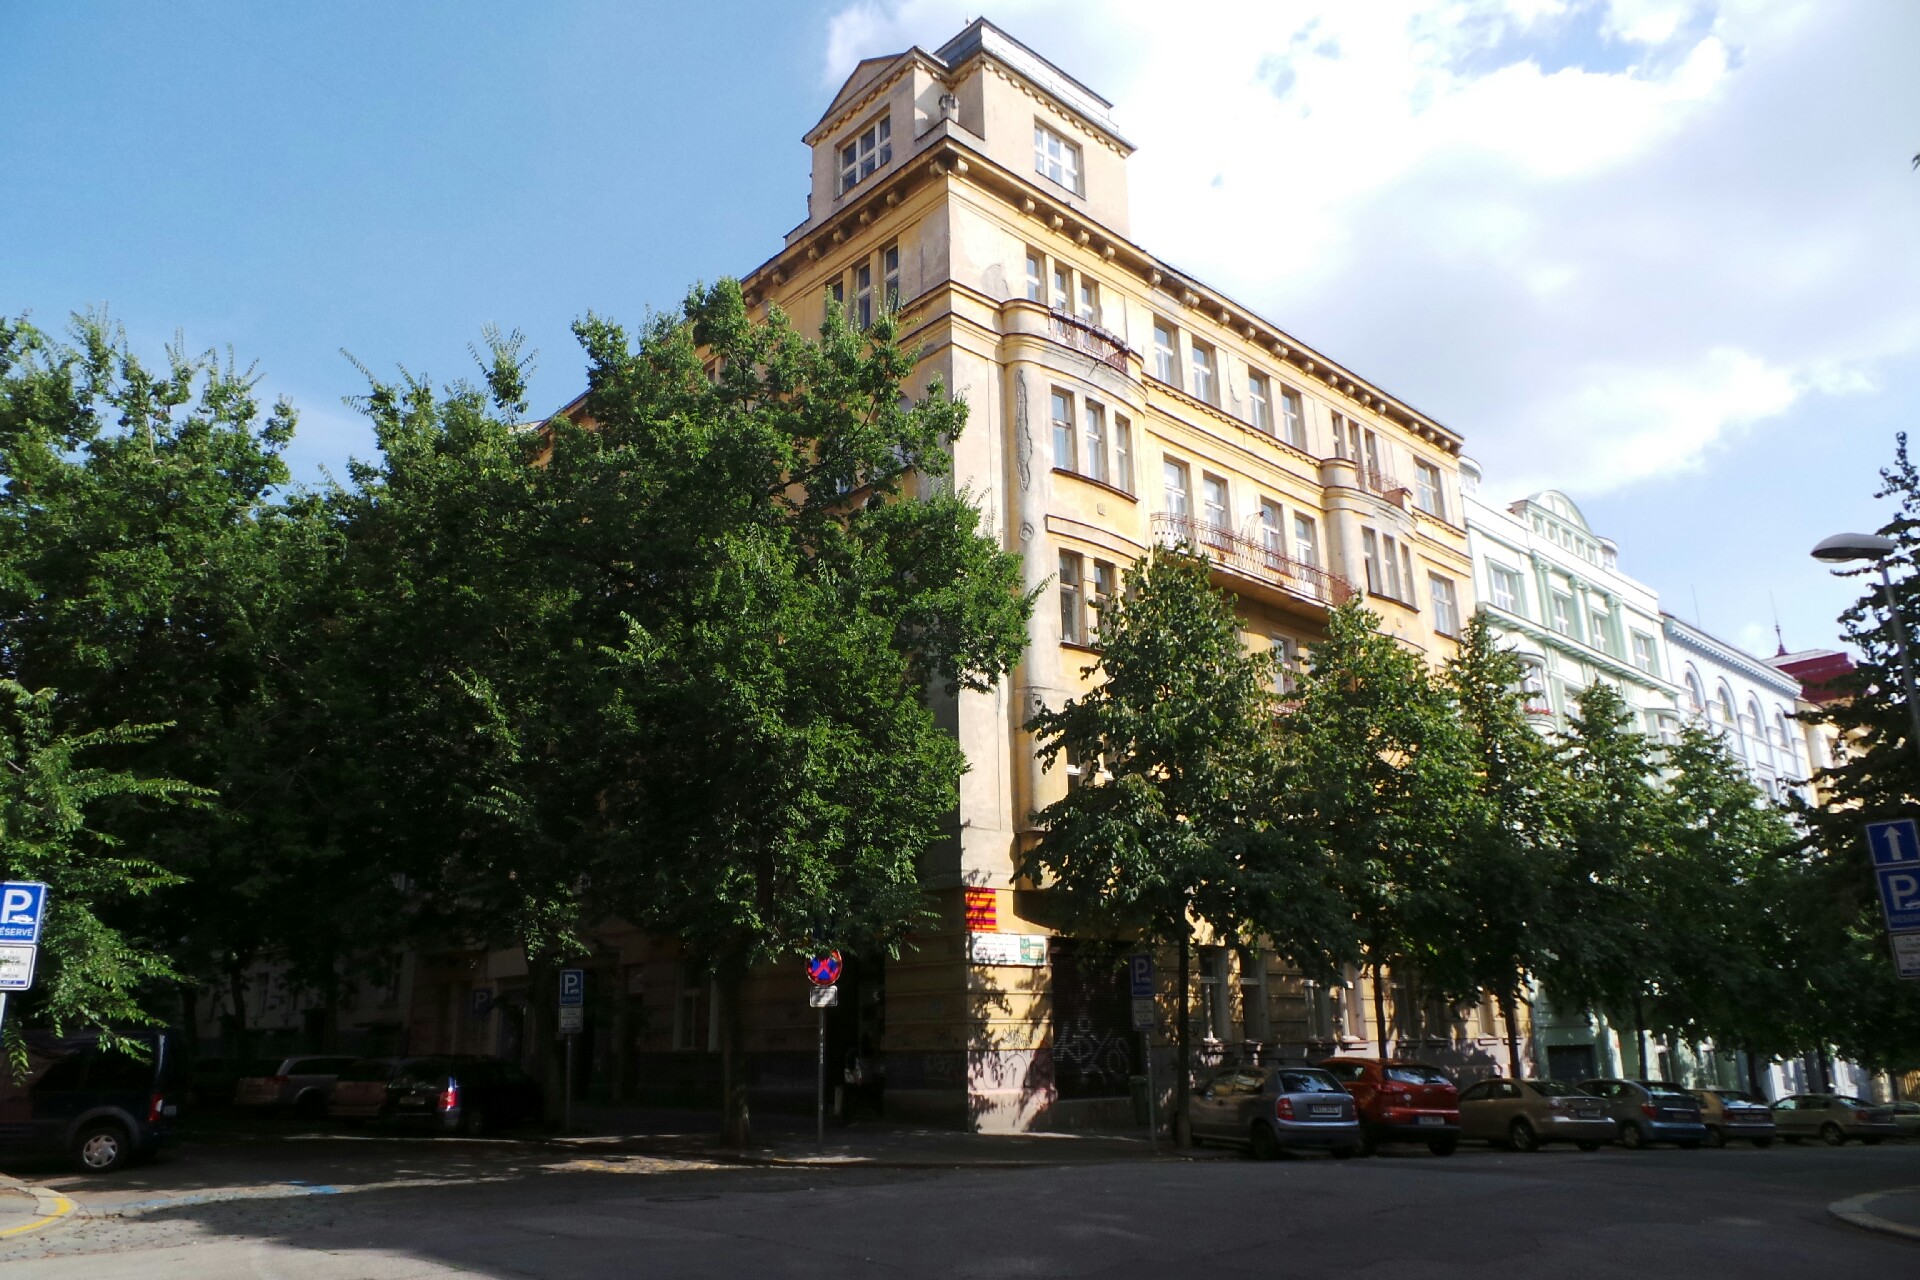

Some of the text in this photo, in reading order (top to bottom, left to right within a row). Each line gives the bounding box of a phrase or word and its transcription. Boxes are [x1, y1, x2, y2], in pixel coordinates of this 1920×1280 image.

[1888, 874, 1919, 911] P
[1, 889, 33, 924] P
[1135, 958, 1148, 983] P
[564, 974, 578, 994] P
[475, 992, 488, 1008] P
